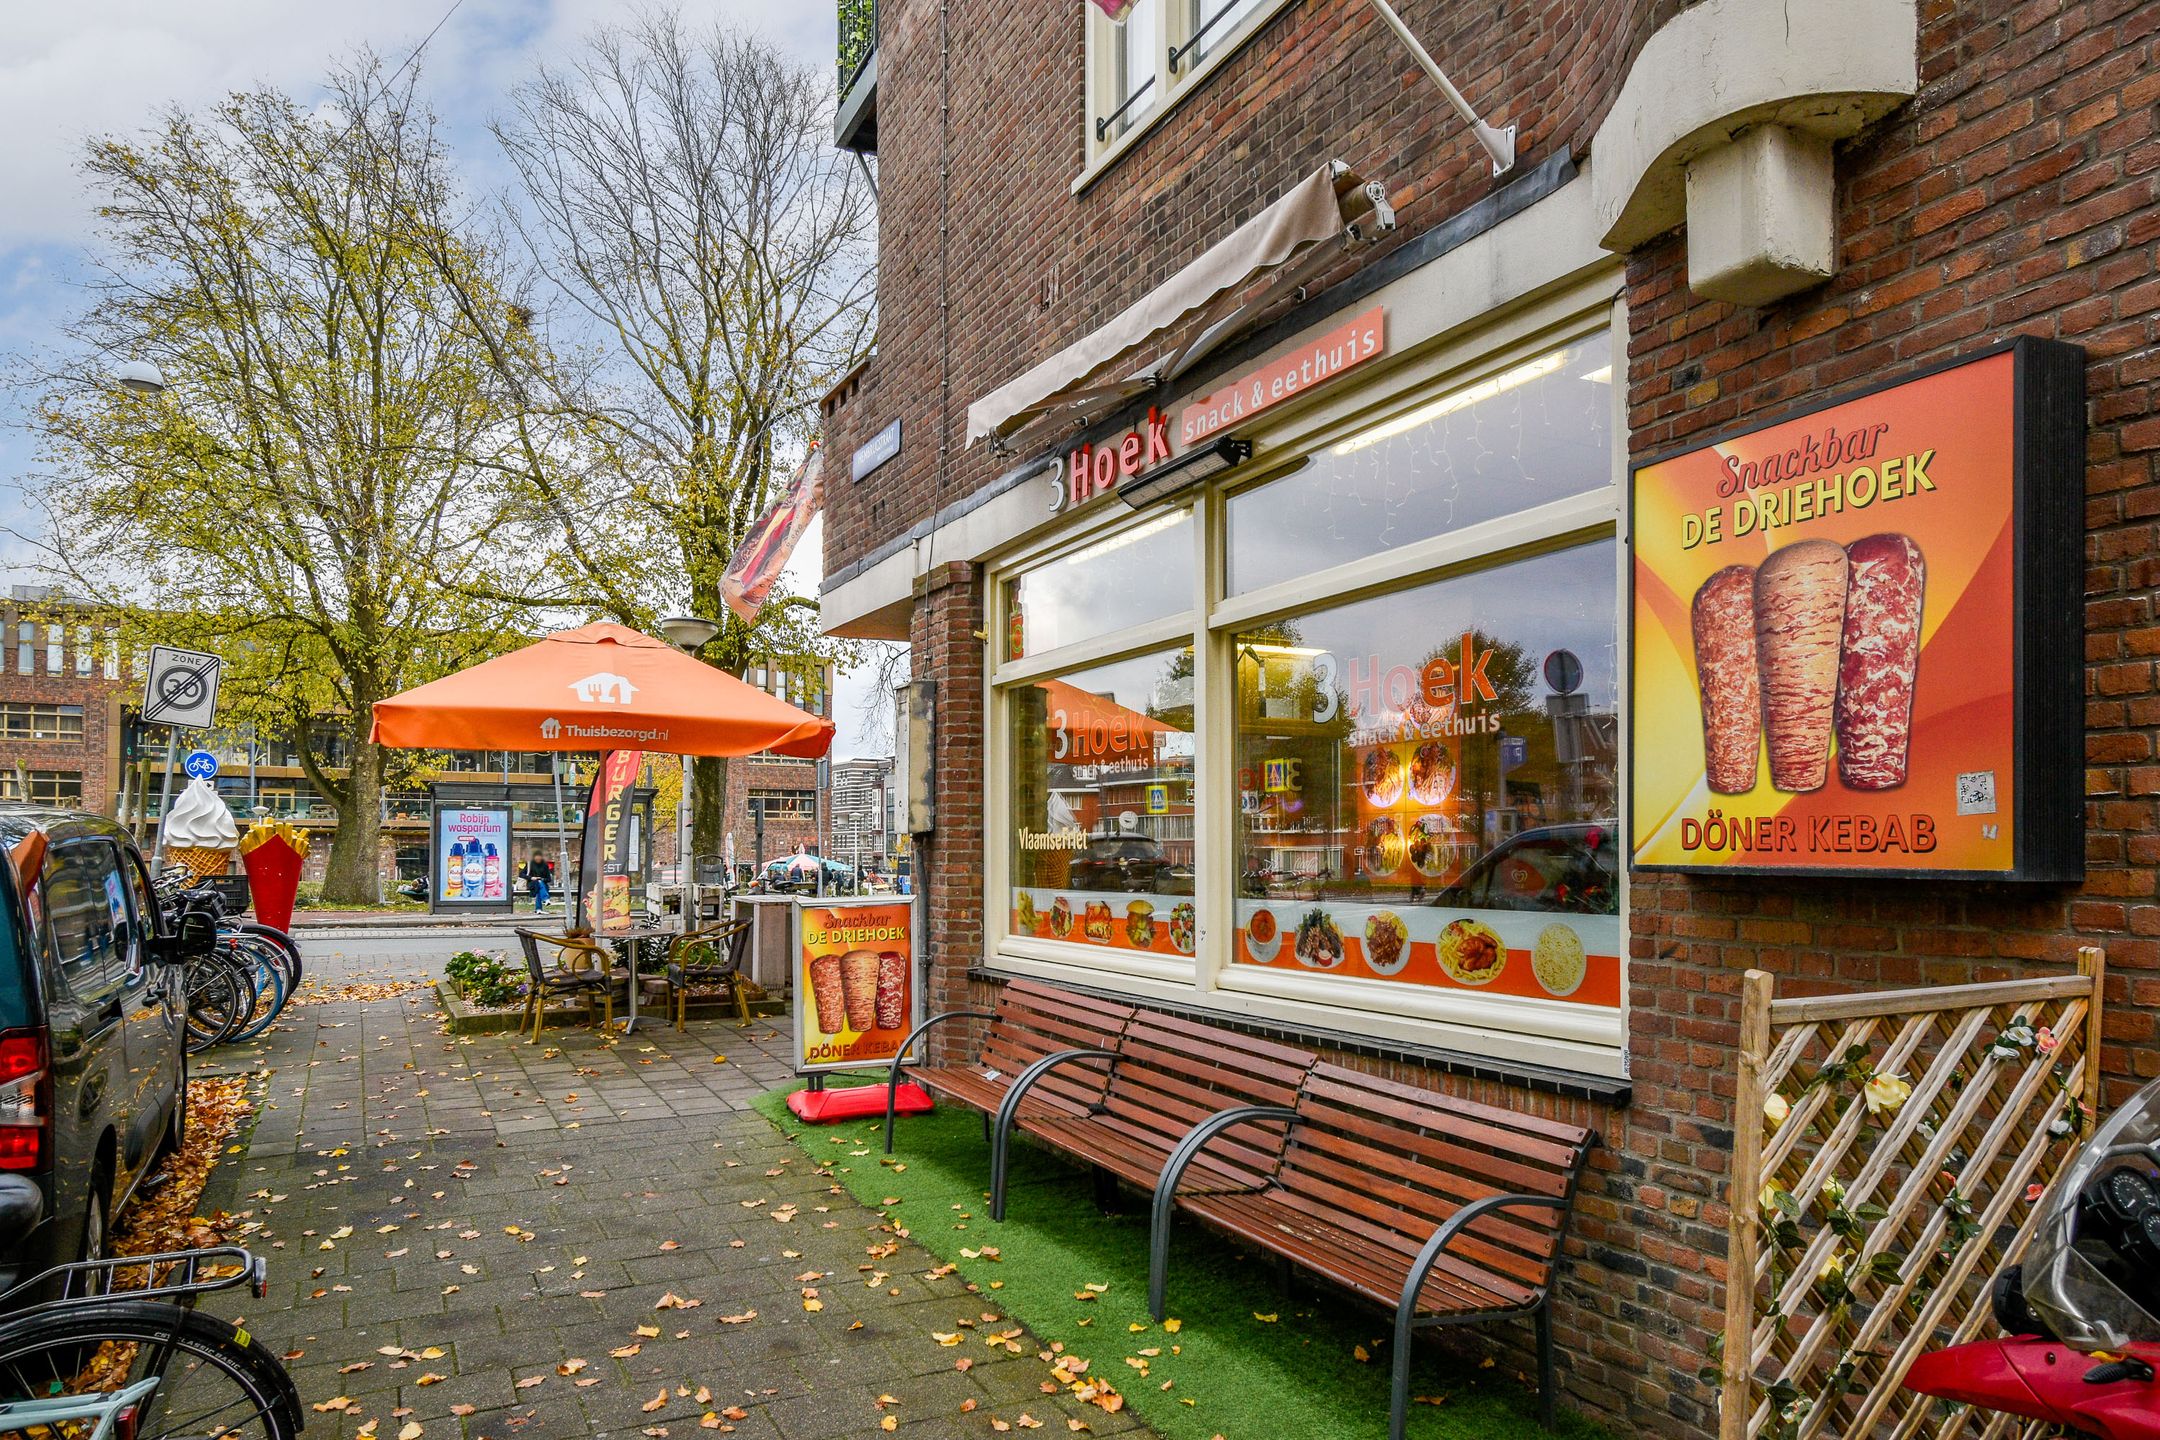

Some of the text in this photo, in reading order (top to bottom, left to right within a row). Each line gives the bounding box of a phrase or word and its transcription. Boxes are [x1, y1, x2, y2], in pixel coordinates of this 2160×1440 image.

[1185, 391, 1243, 441] snack
[1251, 380, 1264, 409] &
[1271, 329, 1376, 398] eethuis
[1716, 422, 1888, 498] Snackbar
[1681, 449, 1936, 550] DE DRIEHOEK
[172, 654, 202, 666] ZONE
[166, 678, 199, 698] 30
[565, 725, 669, 742] Thuisbezorgd.nl
[1349, 708, 1501, 748] snack & eethuis
[1072, 760, 1098, 780] snack
[1109, 754, 1149, 774] eethuis
[603, 750, 631, 861] BURGER
[448, 824, 501, 834] wasparfum
[460, 813, 490, 825] Robijn
[1682, 808, 1937, 854] DÖNER KEBAB
[824, 912, 892, 929] Snackbar
[807, 926, 906, 945] DE DRIEHOEK
[809, 1039, 903, 1060] DÖNER KEBA
